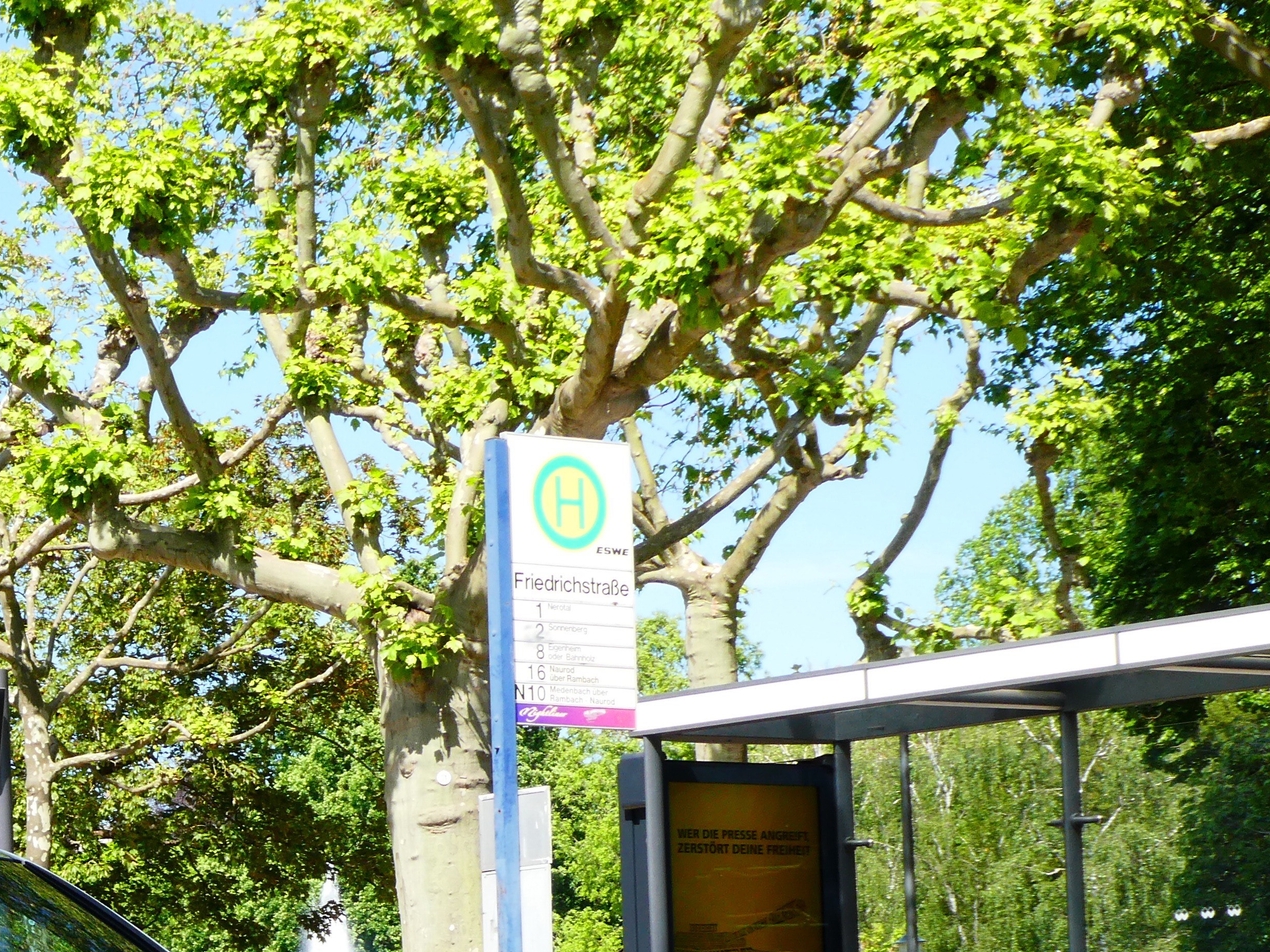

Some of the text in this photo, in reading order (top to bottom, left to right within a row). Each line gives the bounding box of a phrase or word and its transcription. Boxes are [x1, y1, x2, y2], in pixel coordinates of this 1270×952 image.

[555, 475, 586, 529] H
[596, 546, 630, 556] ESWE
[514, 572, 629, 597] Friedrichstraße
[536, 603, 571, 618] 1 Nerotal
[535, 623, 588, 639] 2 Sonnenberg
[536, 643, 545, 660] 8
[548, 653, 596, 662] oder Bahnholz
[528, 665, 575, 681] 16 Naurod
[549, 674, 599, 684] über Rambach
[515, 683, 609, 701] N10 Medenbach über
[550, 694, 583, 704] Rambach
[589, 697, 616, 706] Naurod
[677, 829, 699, 839] WER
[702, 829, 719, 840] DIE
[722, 830, 757, 840] PRESSE
[677, 841, 729, 854] ZERSTÖRT
[732, 844, 763, 855] DEINE
